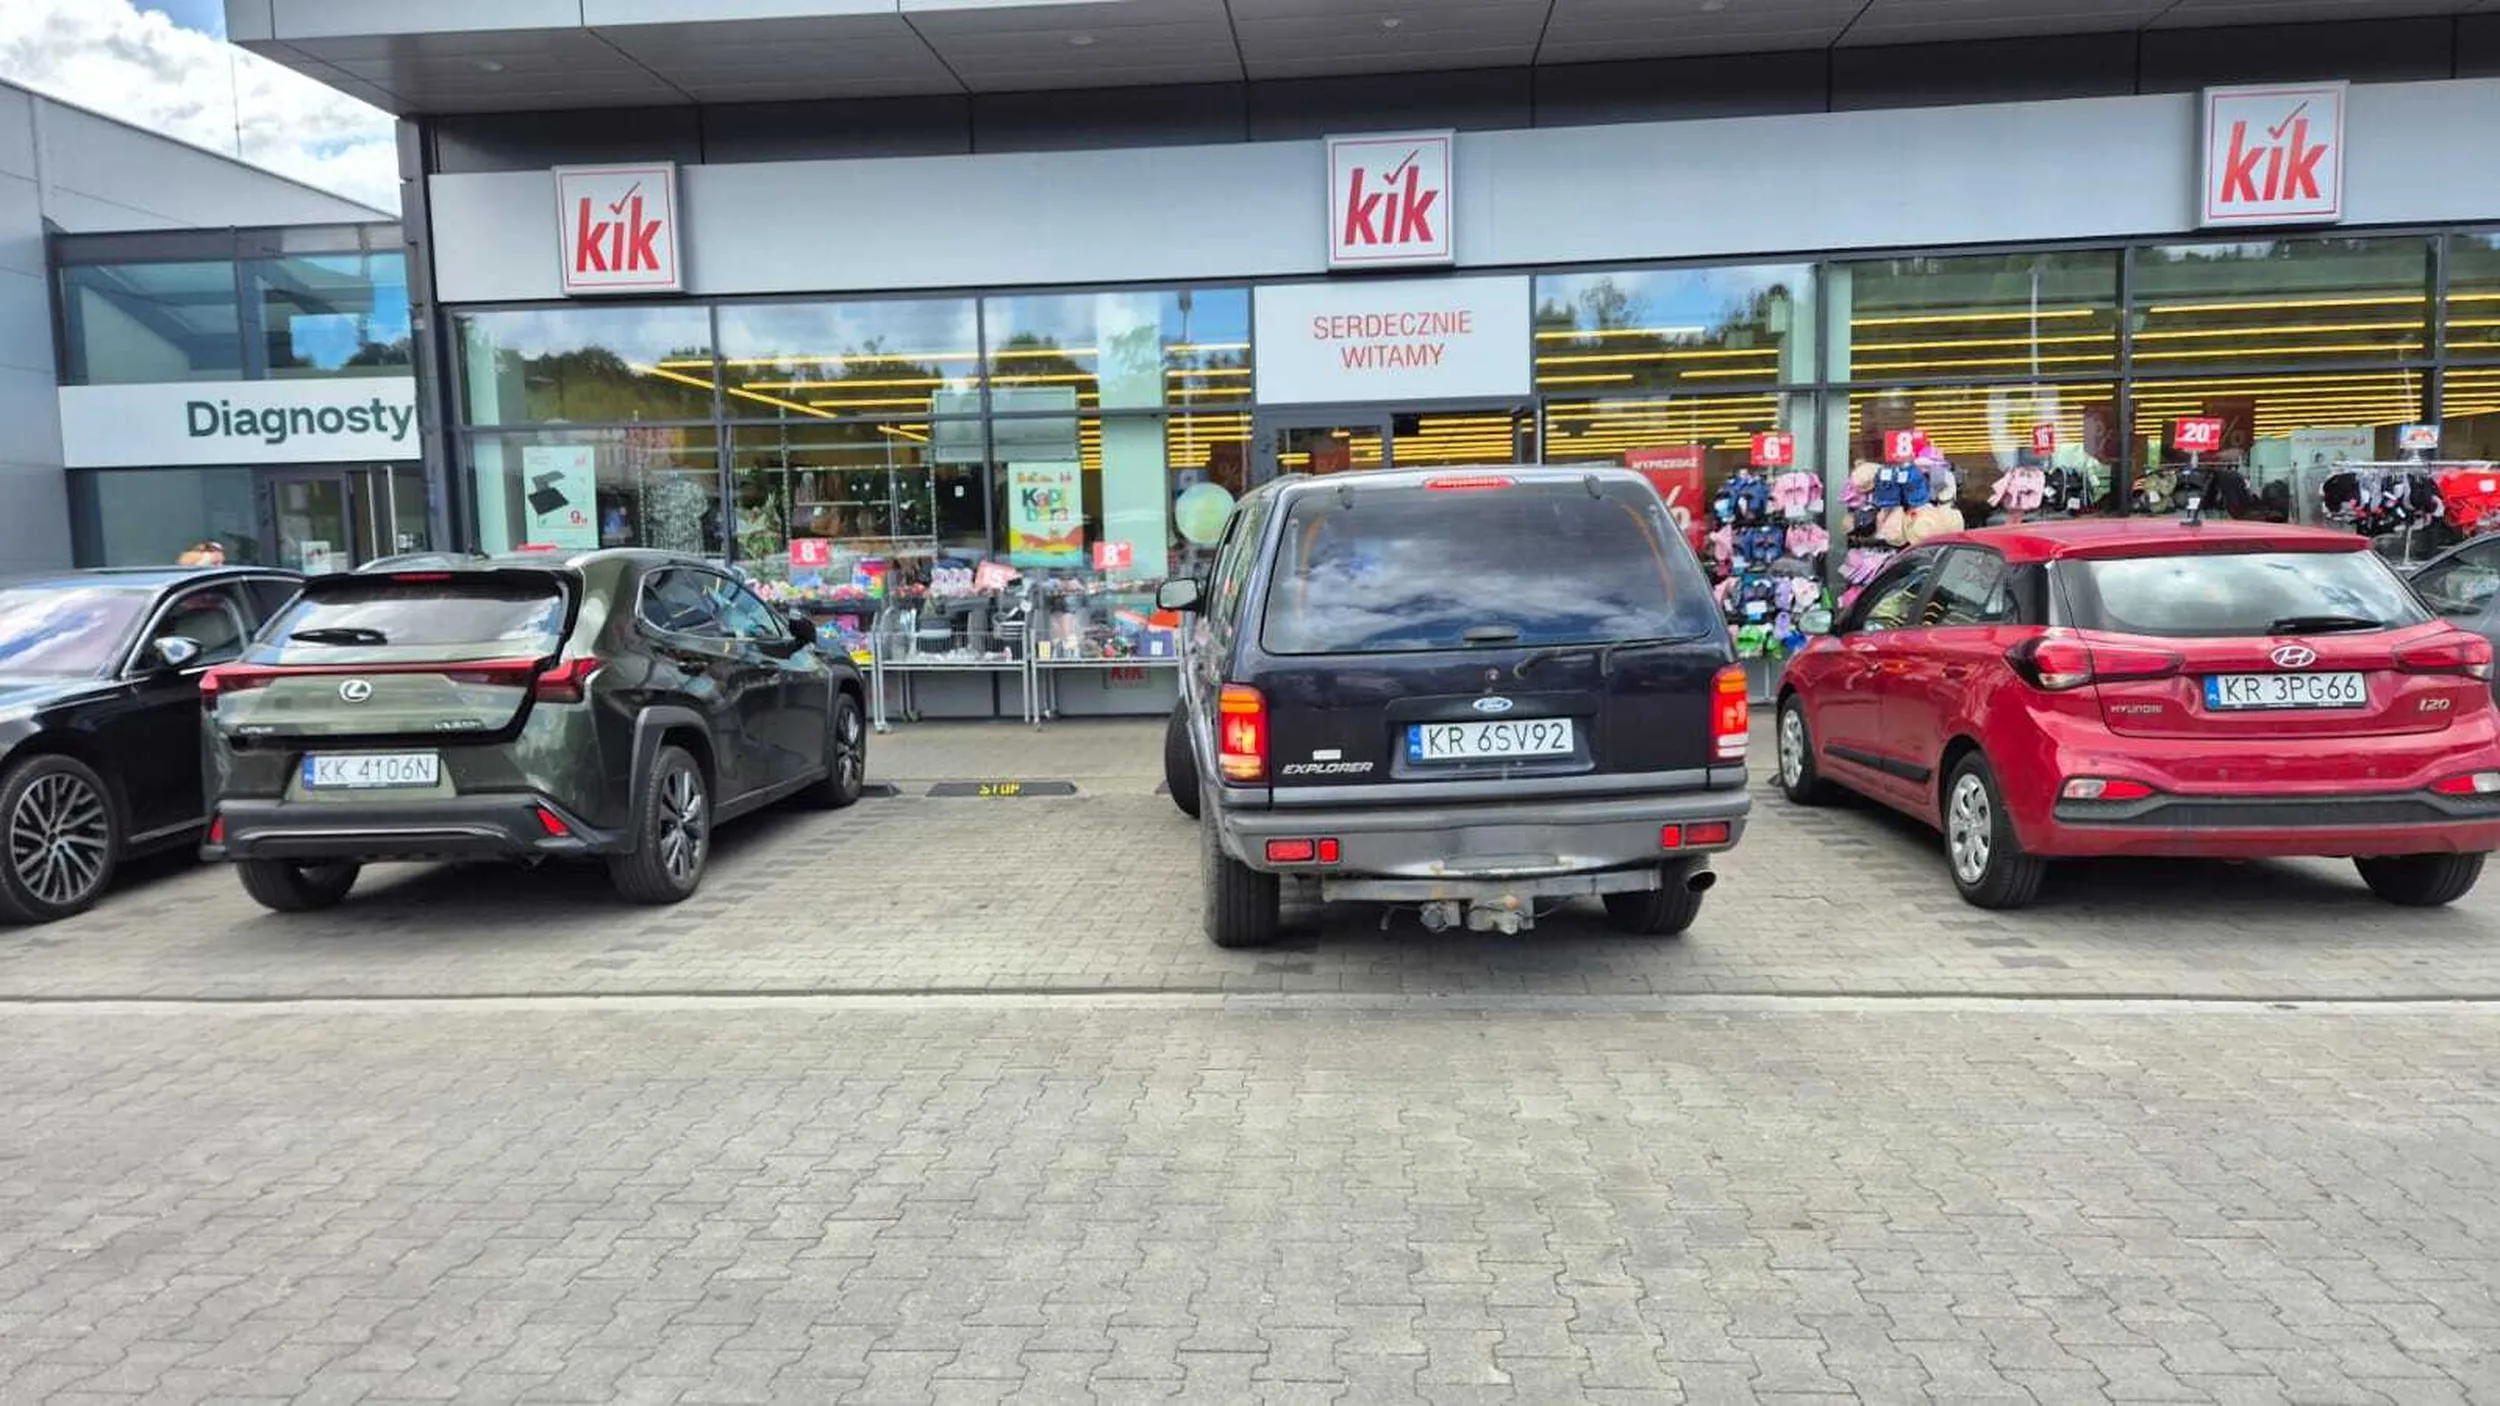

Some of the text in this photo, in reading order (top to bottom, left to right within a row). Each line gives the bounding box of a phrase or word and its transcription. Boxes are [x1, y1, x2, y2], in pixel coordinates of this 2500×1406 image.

[2220, 100, 2328, 202] kik
[1344, 149, 1439, 246] kik
[576, 181, 662, 272] kik
[1313, 310, 1472, 340] SERDECZNIE
[1341, 343, 1445, 369] WITAMY
[186, 397, 413, 444] Diagnosty
[2225, 674, 2357, 701] KR 3PG66
[1428, 722, 1566, 755] KR 6SV92
[318, 757, 431, 780] KK 4106N
[1282, 761, 1374, 775] EXPLORER
[979, 782, 1020, 797] STOP
